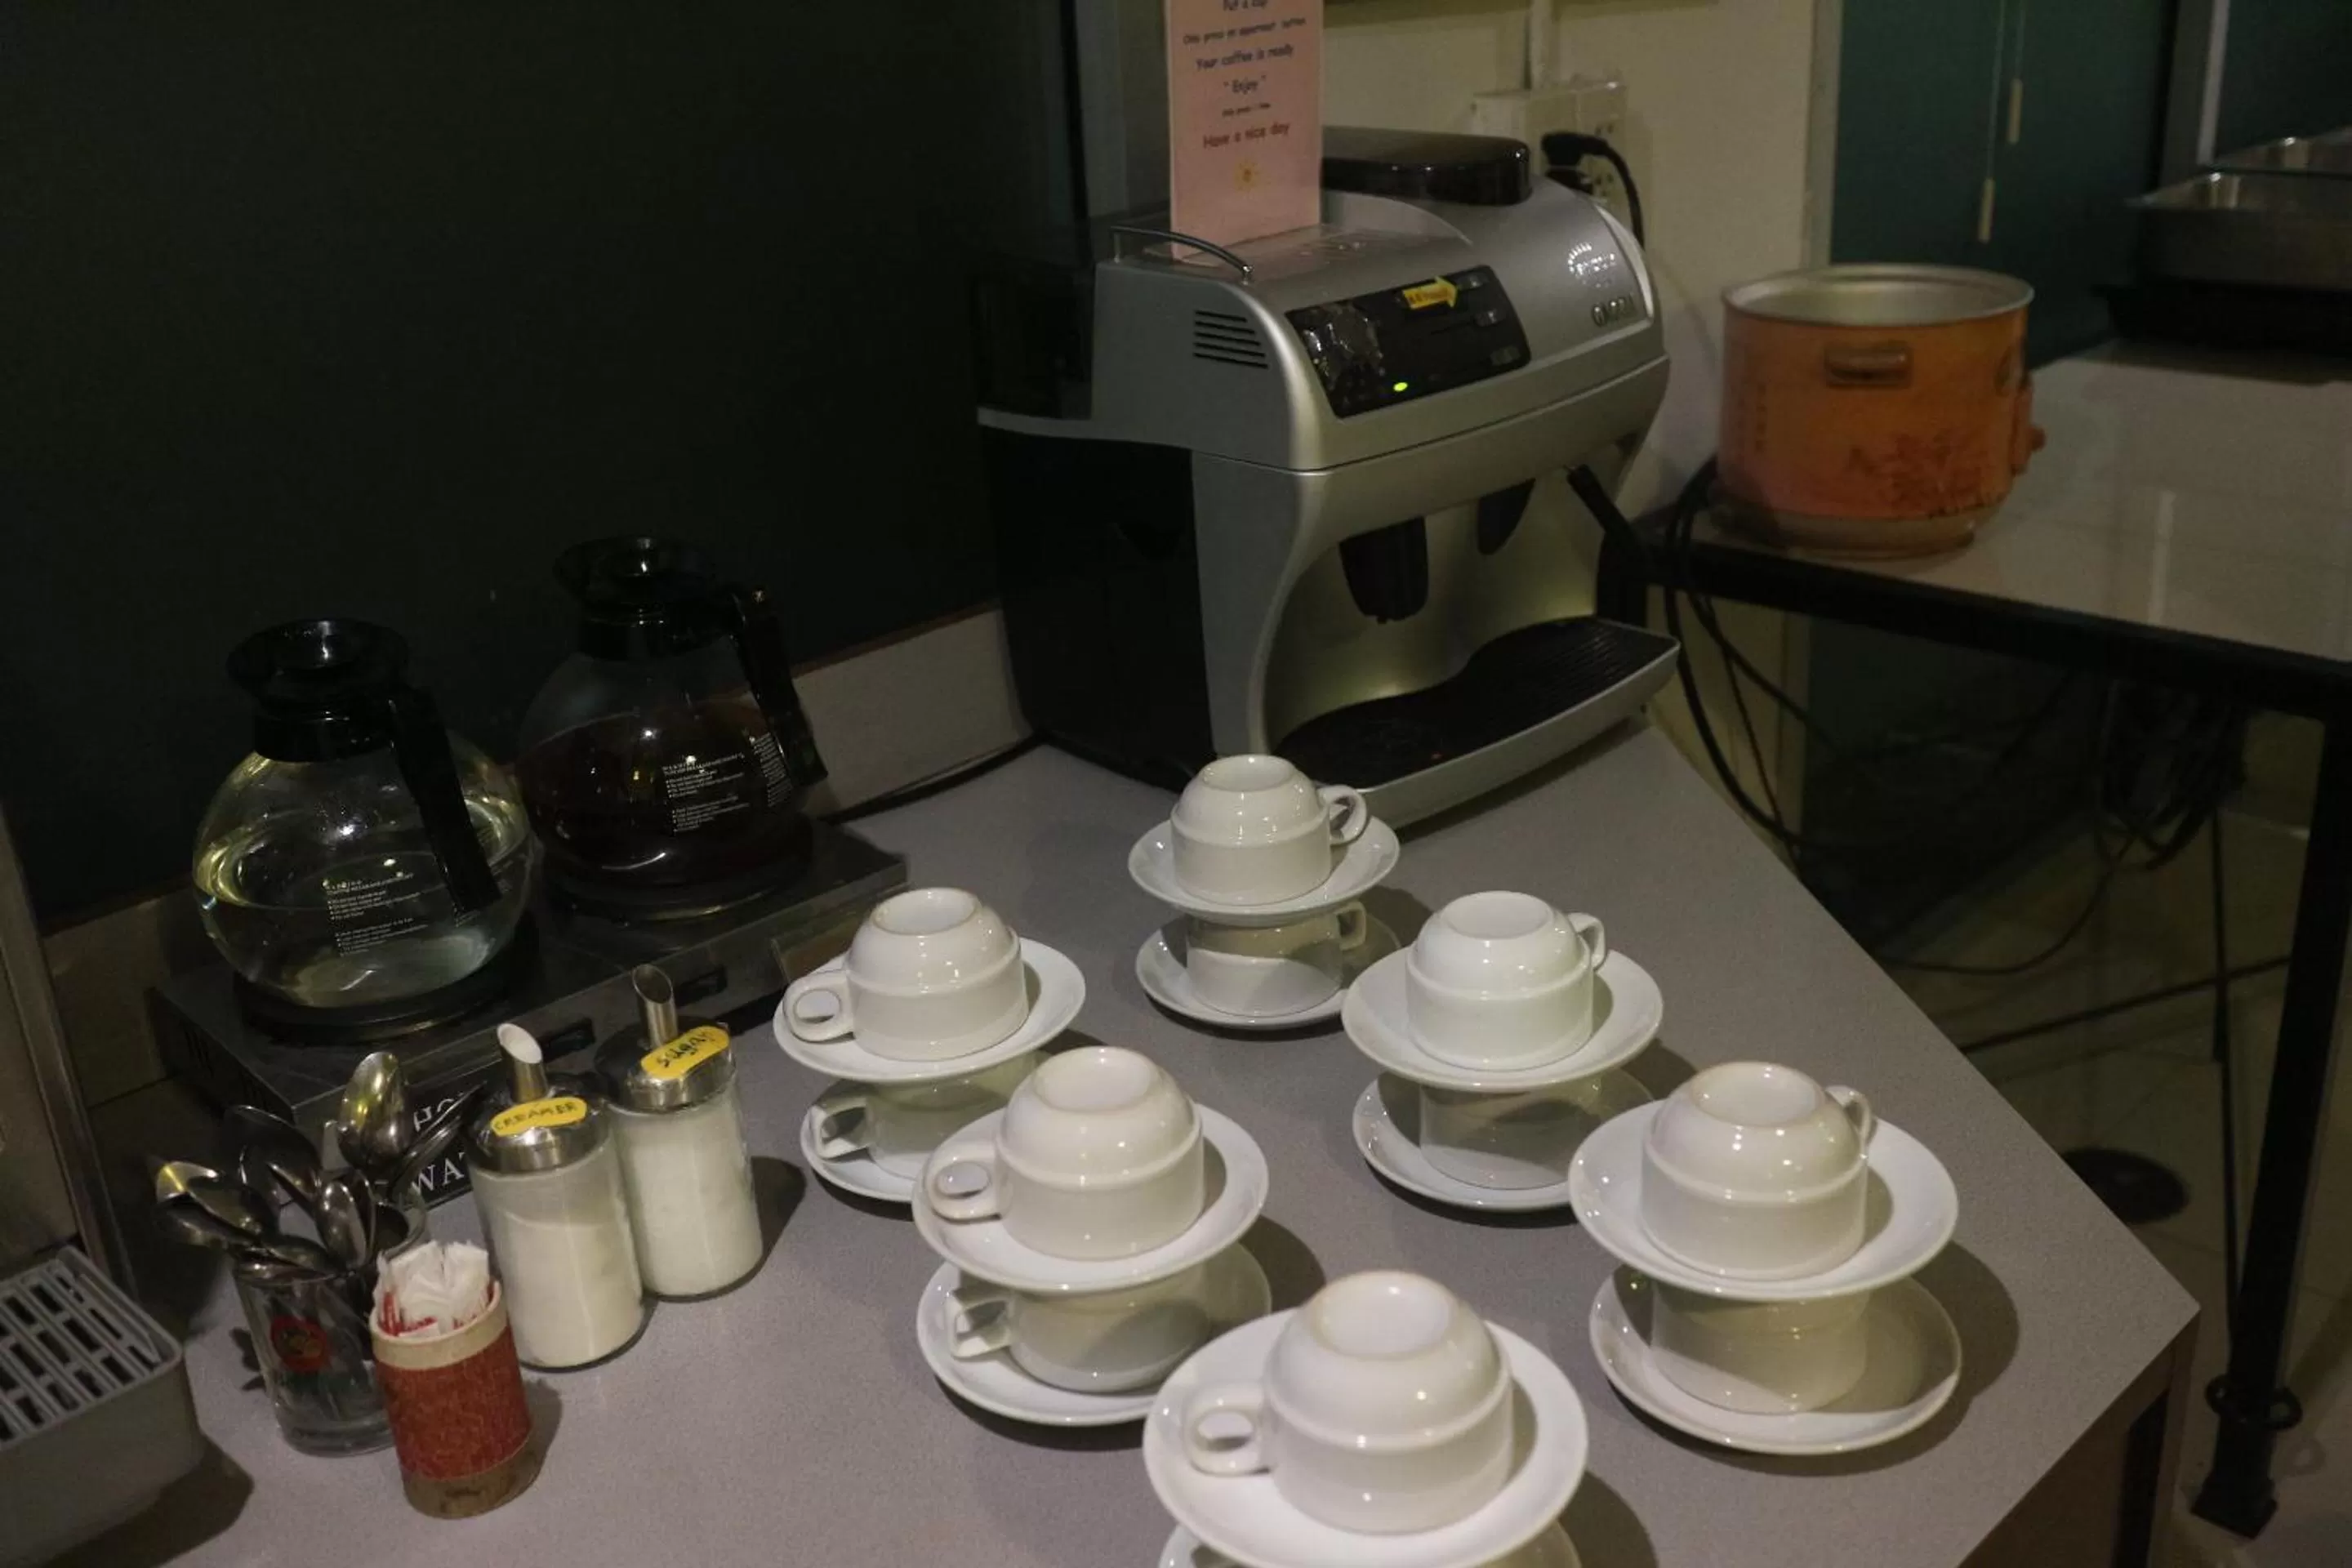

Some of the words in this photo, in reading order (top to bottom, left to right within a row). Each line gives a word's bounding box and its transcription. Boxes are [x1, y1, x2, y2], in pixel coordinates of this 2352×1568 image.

[1196, 58, 1218, 70] Your
[1222, 50, 1253, 65] coffee
[1256, 48, 1265, 60] is
[1267, 43, 1294, 58] ready
[1203, 134, 1230, 149] Have
[1234, 131, 1242, 143] a
[1245, 127, 1267, 140] nice
[1270, 122, 1290, 138] day
